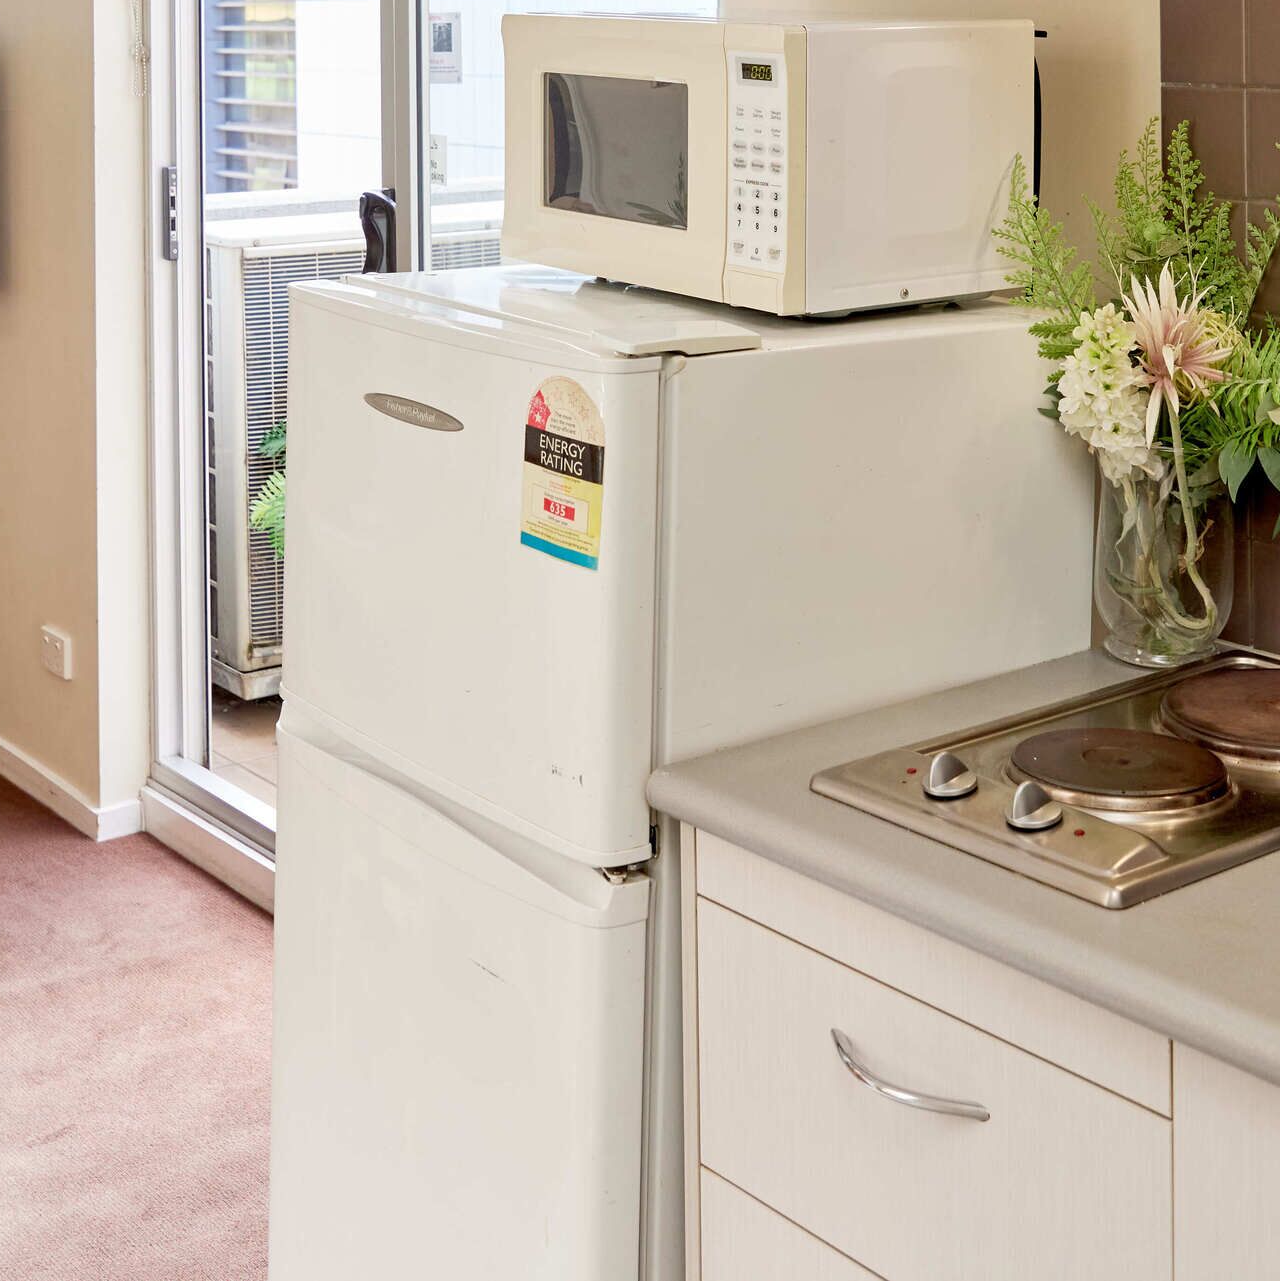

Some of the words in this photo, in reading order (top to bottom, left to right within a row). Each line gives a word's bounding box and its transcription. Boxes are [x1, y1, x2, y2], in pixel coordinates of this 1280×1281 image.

[754, 190, 760, 199] 2
[773, 192, 779, 201] 3
[736, 203, 742, 212] 4
[754, 206, 760, 215] 5
[773, 208, 779, 217] 6
[737, 219, 742, 227] 7
[754, 222, 760, 230] 8
[773, 225, 778, 233] 9
[754, 247, 759, 255] 0
[539, 433, 586, 460] ENERGY
[540, 450, 583, 476] RATING
[549, 502, 567, 517] 635
